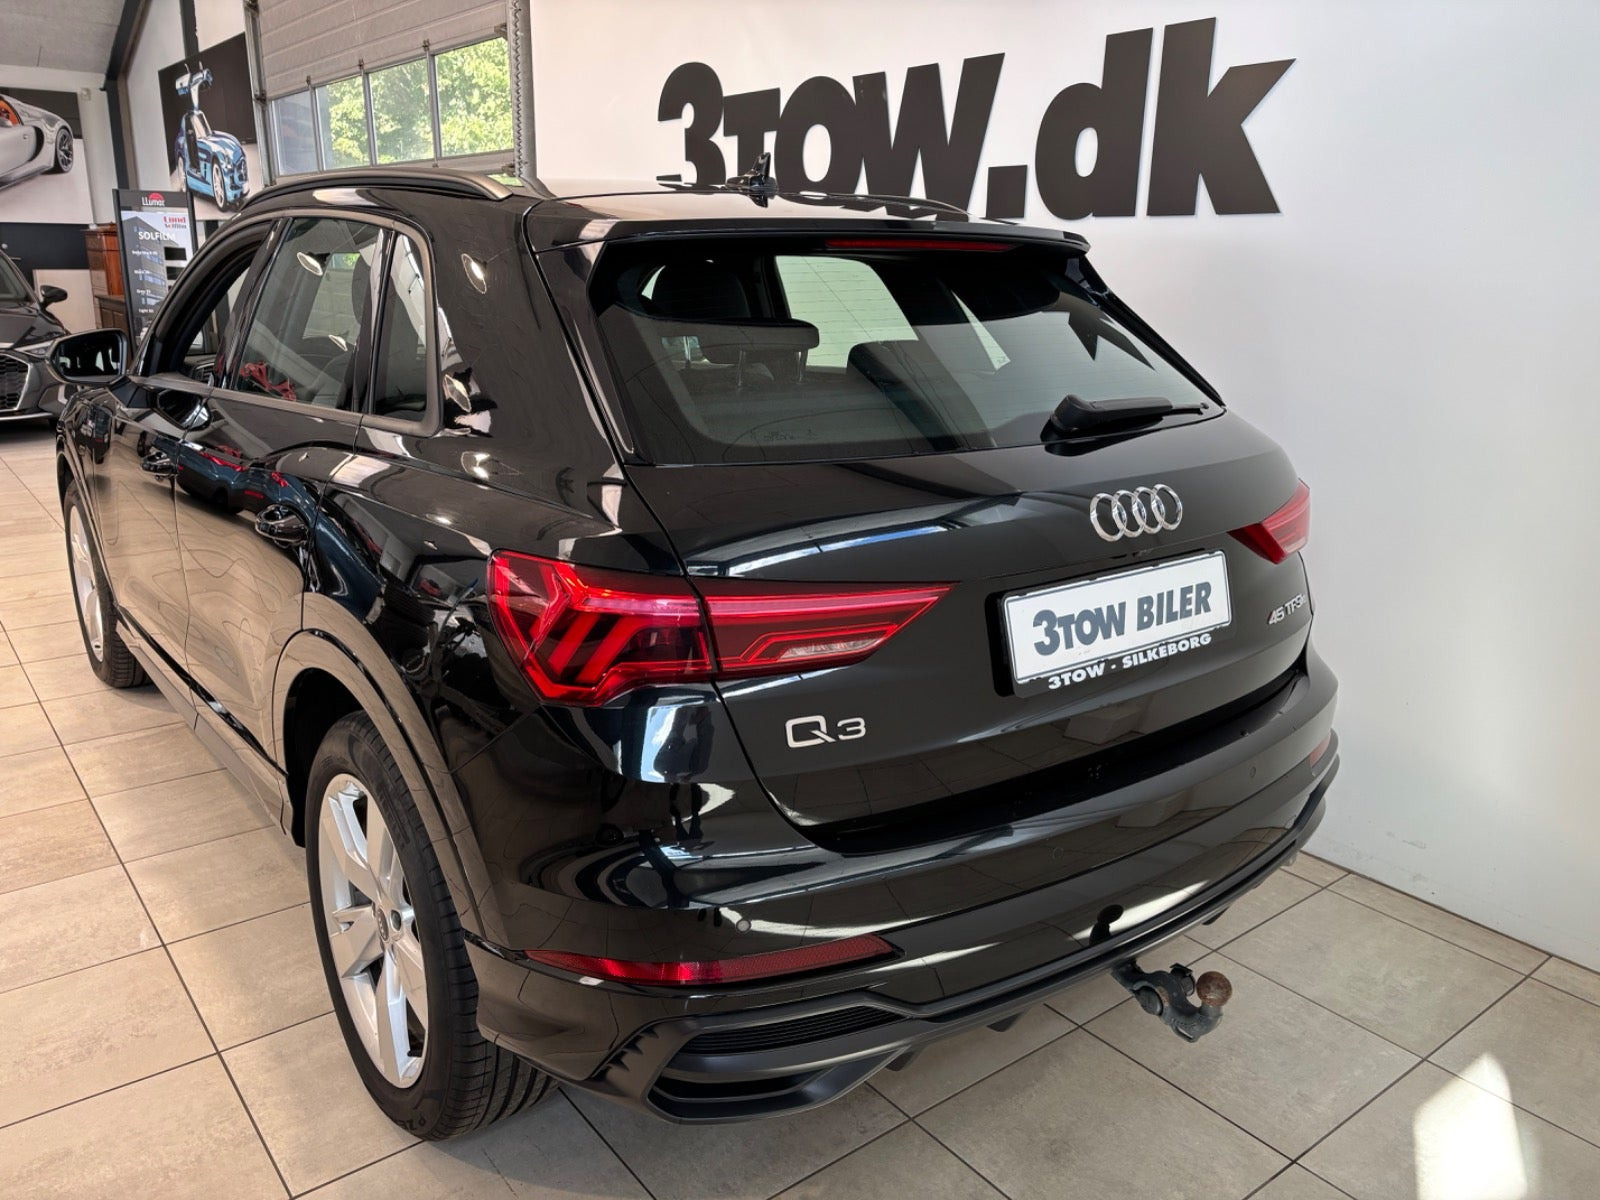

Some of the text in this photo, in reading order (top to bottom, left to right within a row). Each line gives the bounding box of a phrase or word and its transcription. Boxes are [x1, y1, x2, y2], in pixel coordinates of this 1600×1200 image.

[138, 231, 176, 241] SOLFILM
[1032, 581, 1212, 656] 3TOW BILER
[1268, 606, 1285, 625] 45
[1048, 662, 1105, 690] 3TOW
[1122, 633, 1212, 669] SILKEBORG
[785, 715, 867, 748] Q3
